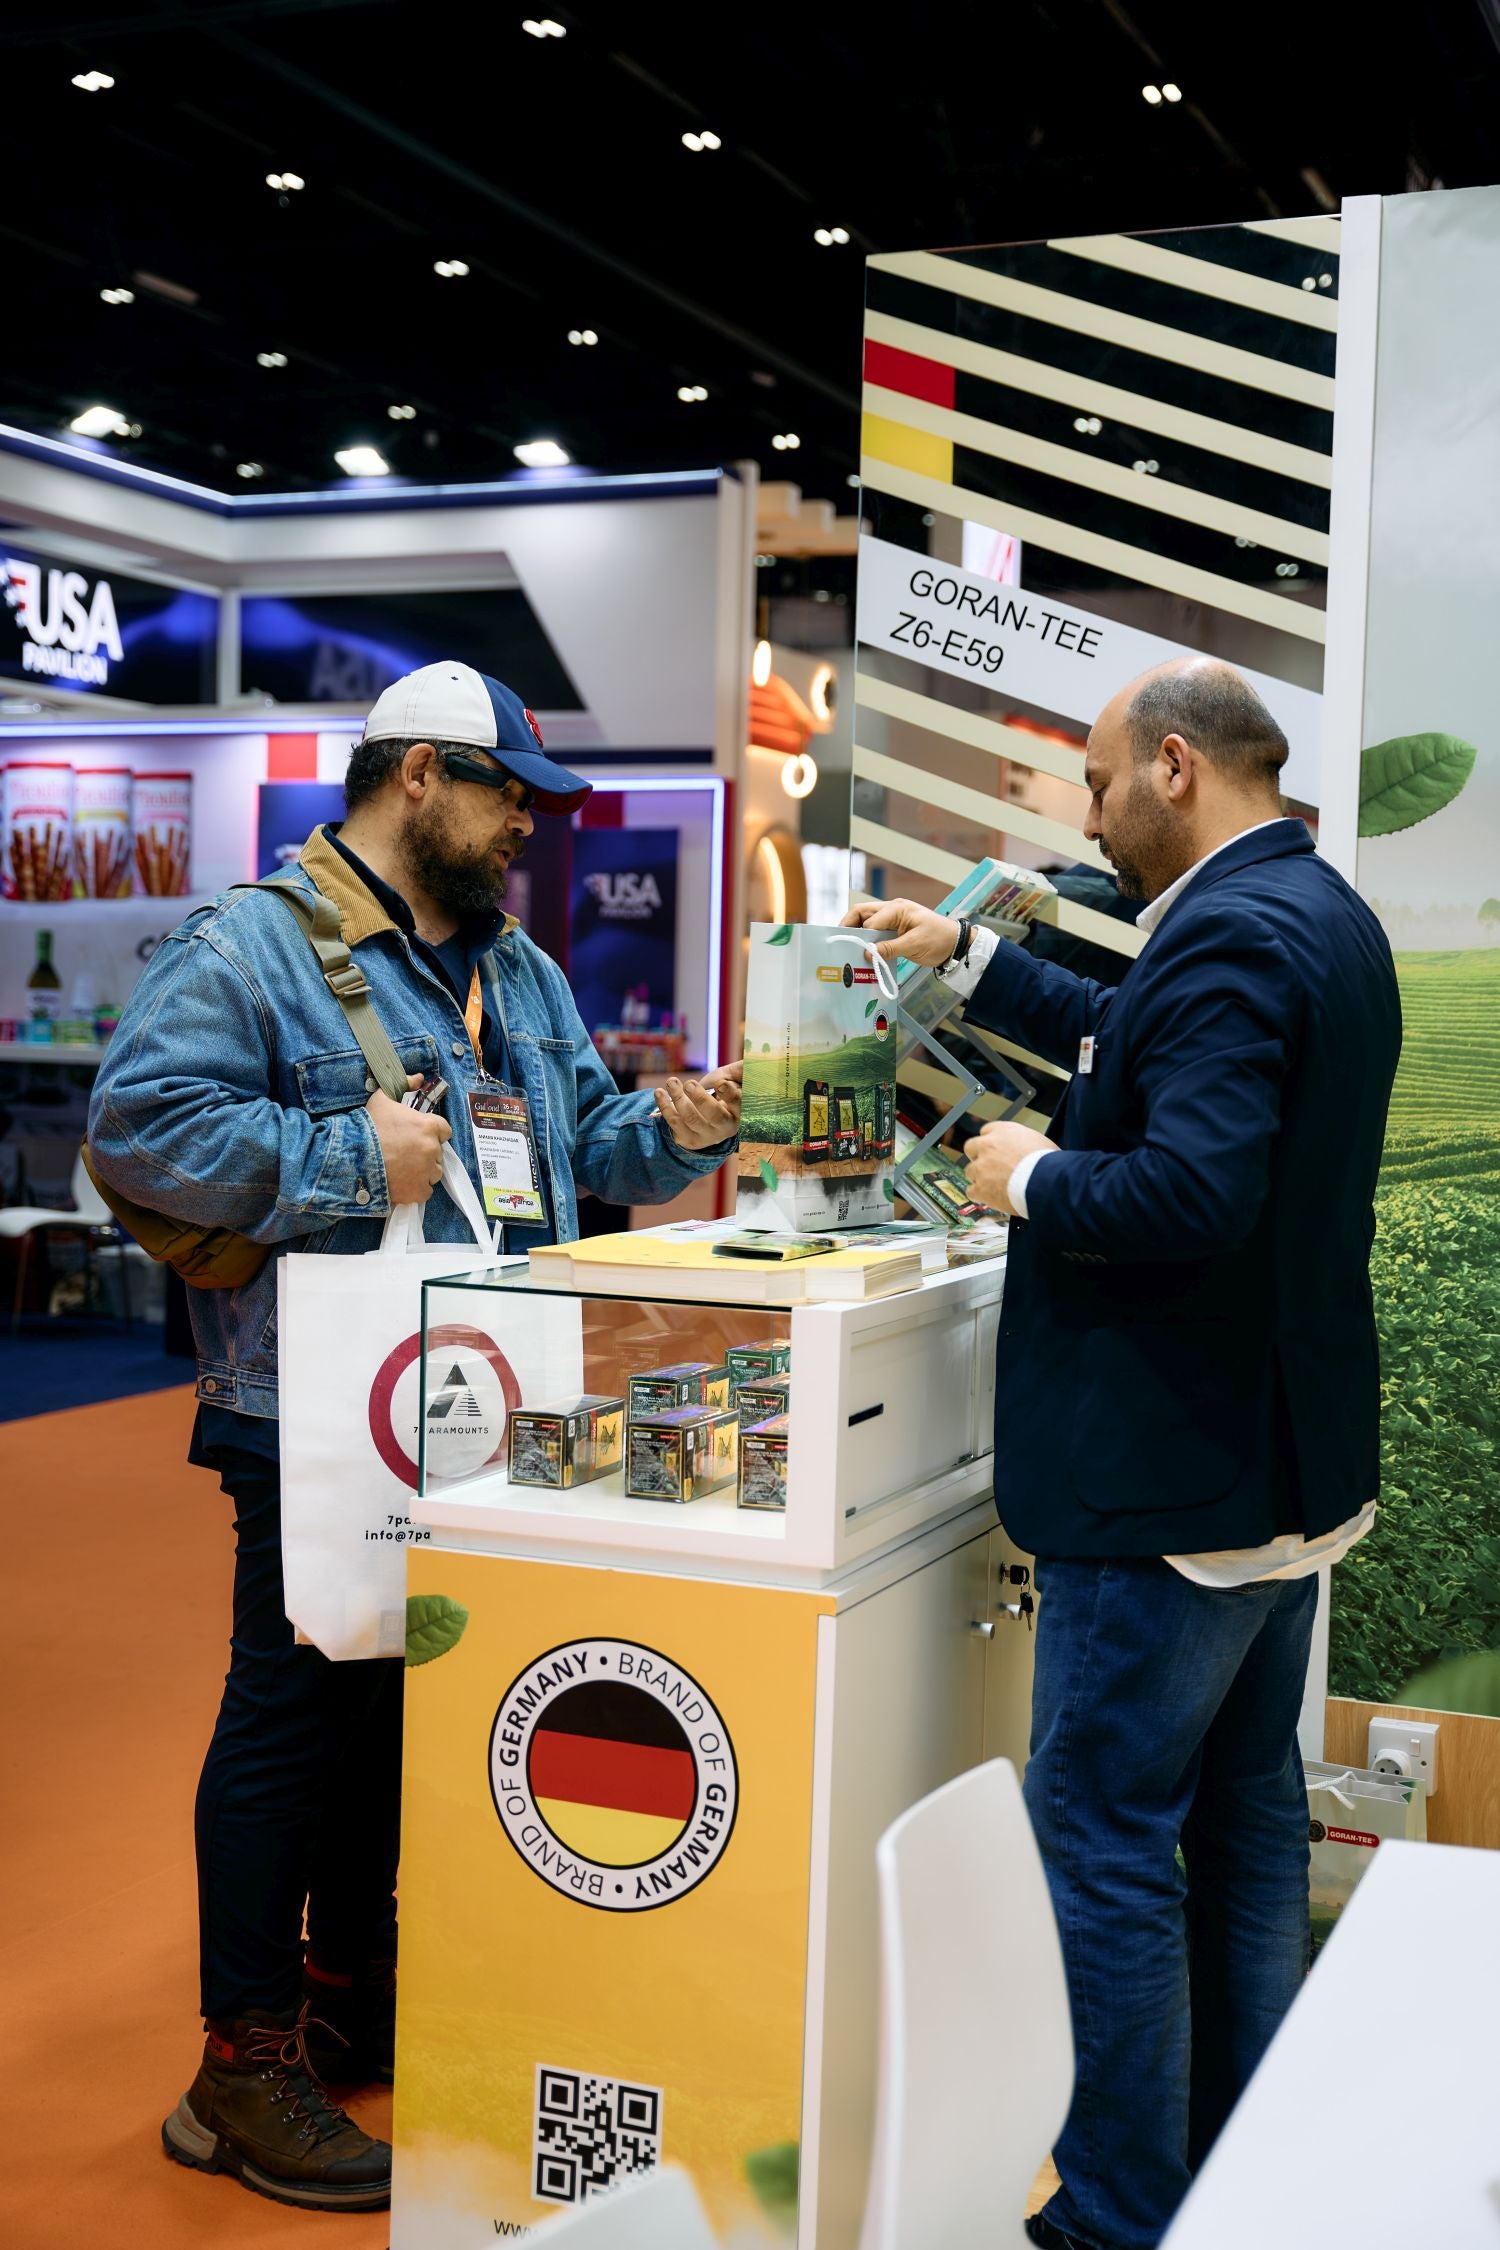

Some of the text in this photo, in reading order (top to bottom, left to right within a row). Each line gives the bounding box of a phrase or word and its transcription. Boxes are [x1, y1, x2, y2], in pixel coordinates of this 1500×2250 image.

[12, 559, 124, 661] USA
[889, 611, 1004, 673] Z6-E59
[909, 570, 1103, 658] GORAN-TEE
[594, 872, 662, 908] USA
[413, 1426, 489, 1434] 7ARAMOUNTS
[499, 1651, 604, 1897] BRAND OF GERMANY
[618, 1652, 727, 1899] BRAND OF GERMANY
